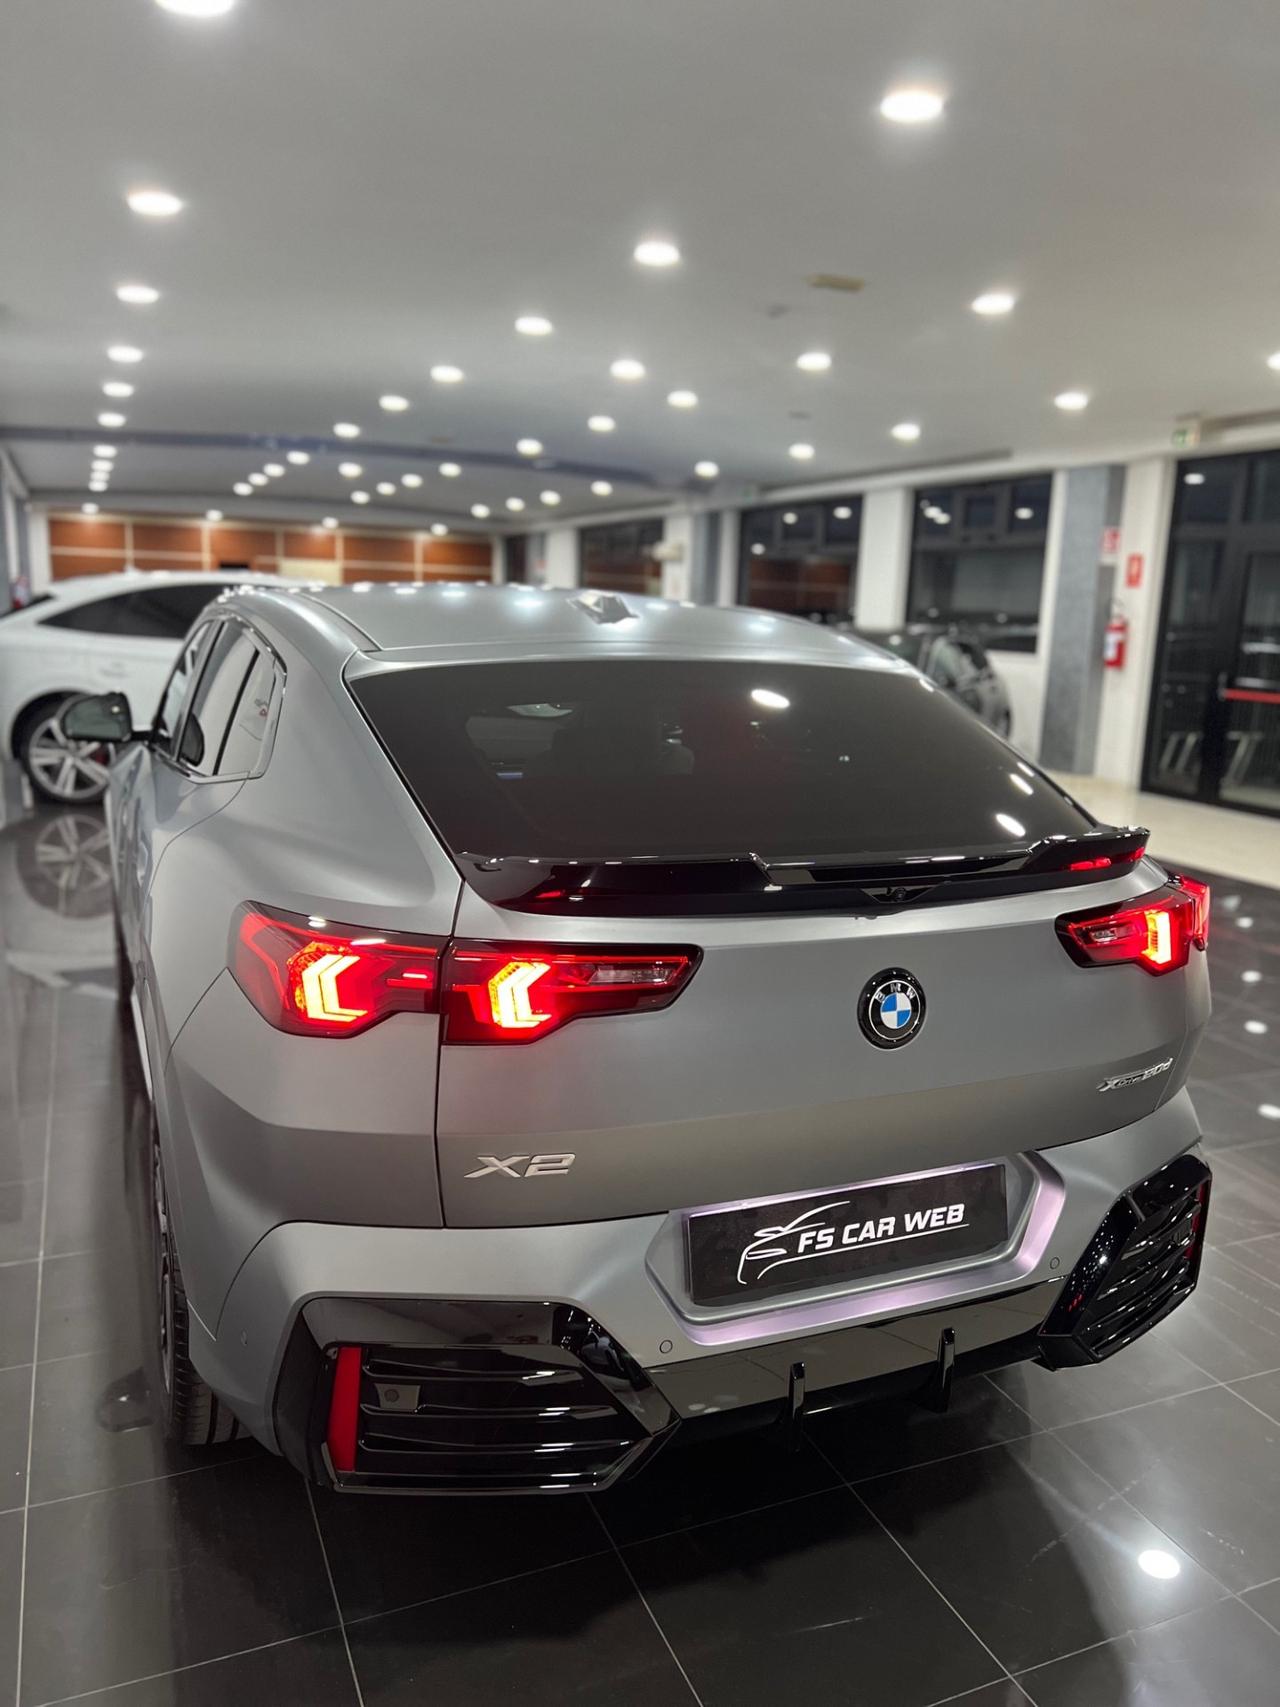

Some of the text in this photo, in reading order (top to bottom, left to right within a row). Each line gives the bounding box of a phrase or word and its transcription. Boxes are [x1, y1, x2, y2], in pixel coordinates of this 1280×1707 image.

[874, 982, 916, 1003] BMW
[464, 1153, 576, 1178] X2
[798, 1203, 965, 1254] FS CAR WEB
